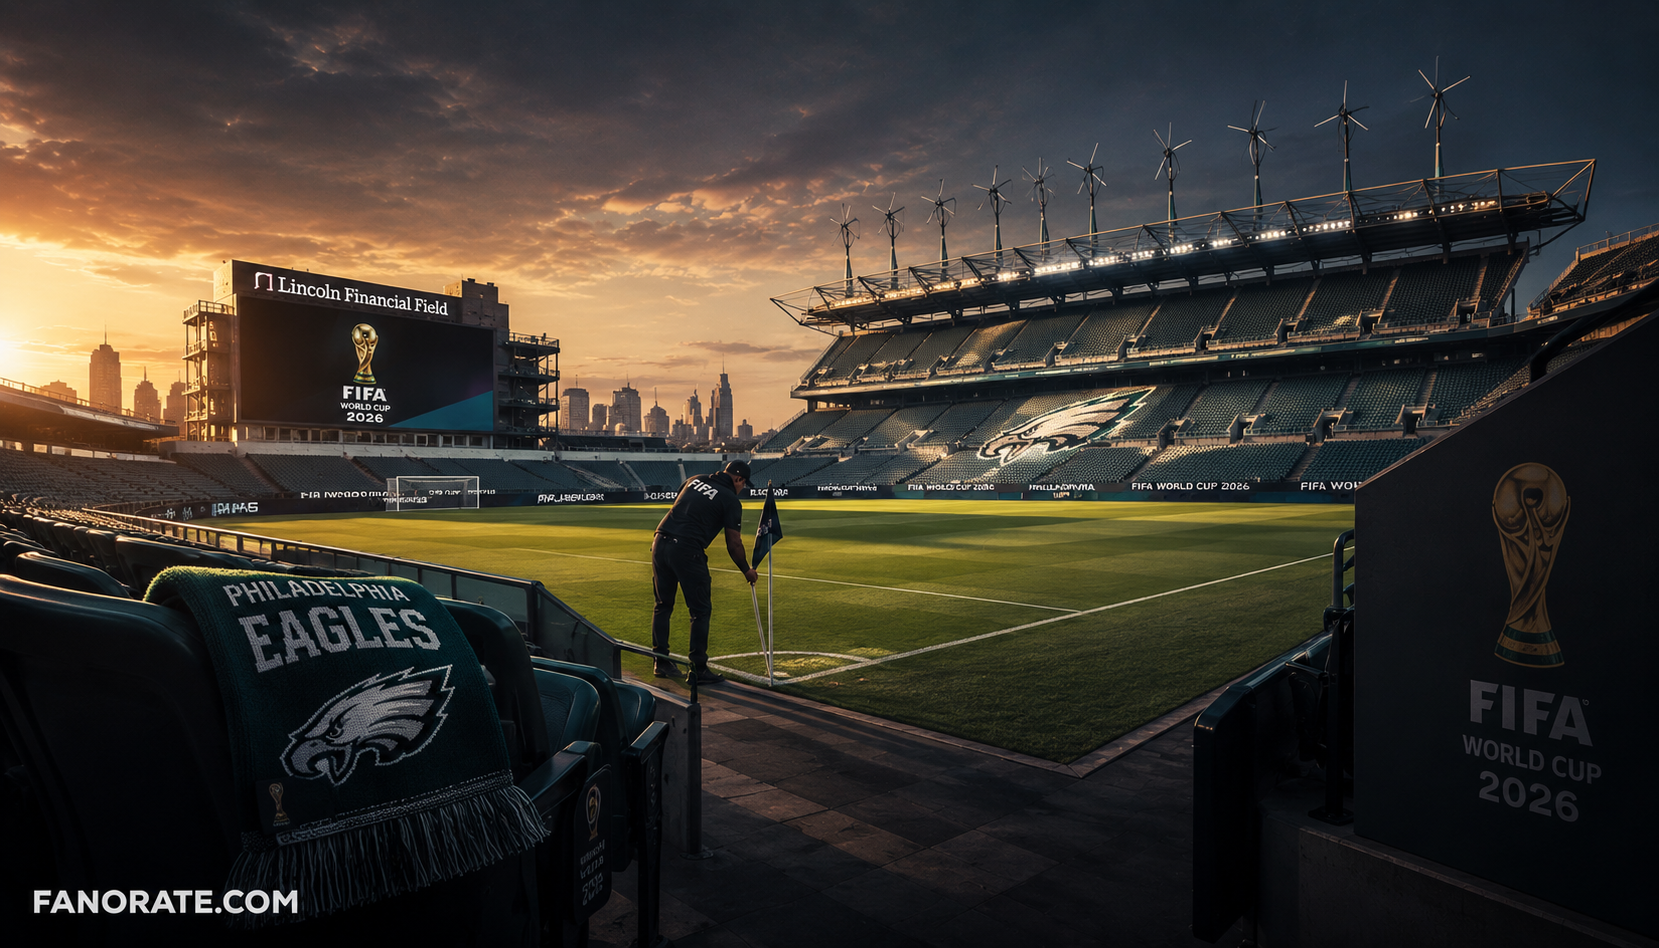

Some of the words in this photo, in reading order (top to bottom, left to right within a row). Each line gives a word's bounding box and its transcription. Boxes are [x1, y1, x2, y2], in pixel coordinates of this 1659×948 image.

[277, 276, 342, 301] Lincoln
[344, 287, 412, 311] Financial
[414, 298, 449, 316] Field
[342, 385, 388, 402] FIFA
[340, 402, 372, 411] WORLD
[373, 404, 391, 412] CUP
[346, 411, 384, 423] 2026
[687, 478, 719, 501] FIFA
[1131, 482, 1153, 491] FIFA
[1156, 482, 1193, 491] WORLD
[1196, 482, 1218, 491] CUP
[1300, 481, 1327, 491] FIFA
[222, 579, 411, 607] PHILADELPHIA
[238, 605, 442, 673] EAGLES
[1470, 679, 1594, 747] FIFA
[1462, 734, 1545, 772] WORLD
[1551, 755, 1602, 785] CUP
[1478, 770, 1579, 823] 2026
